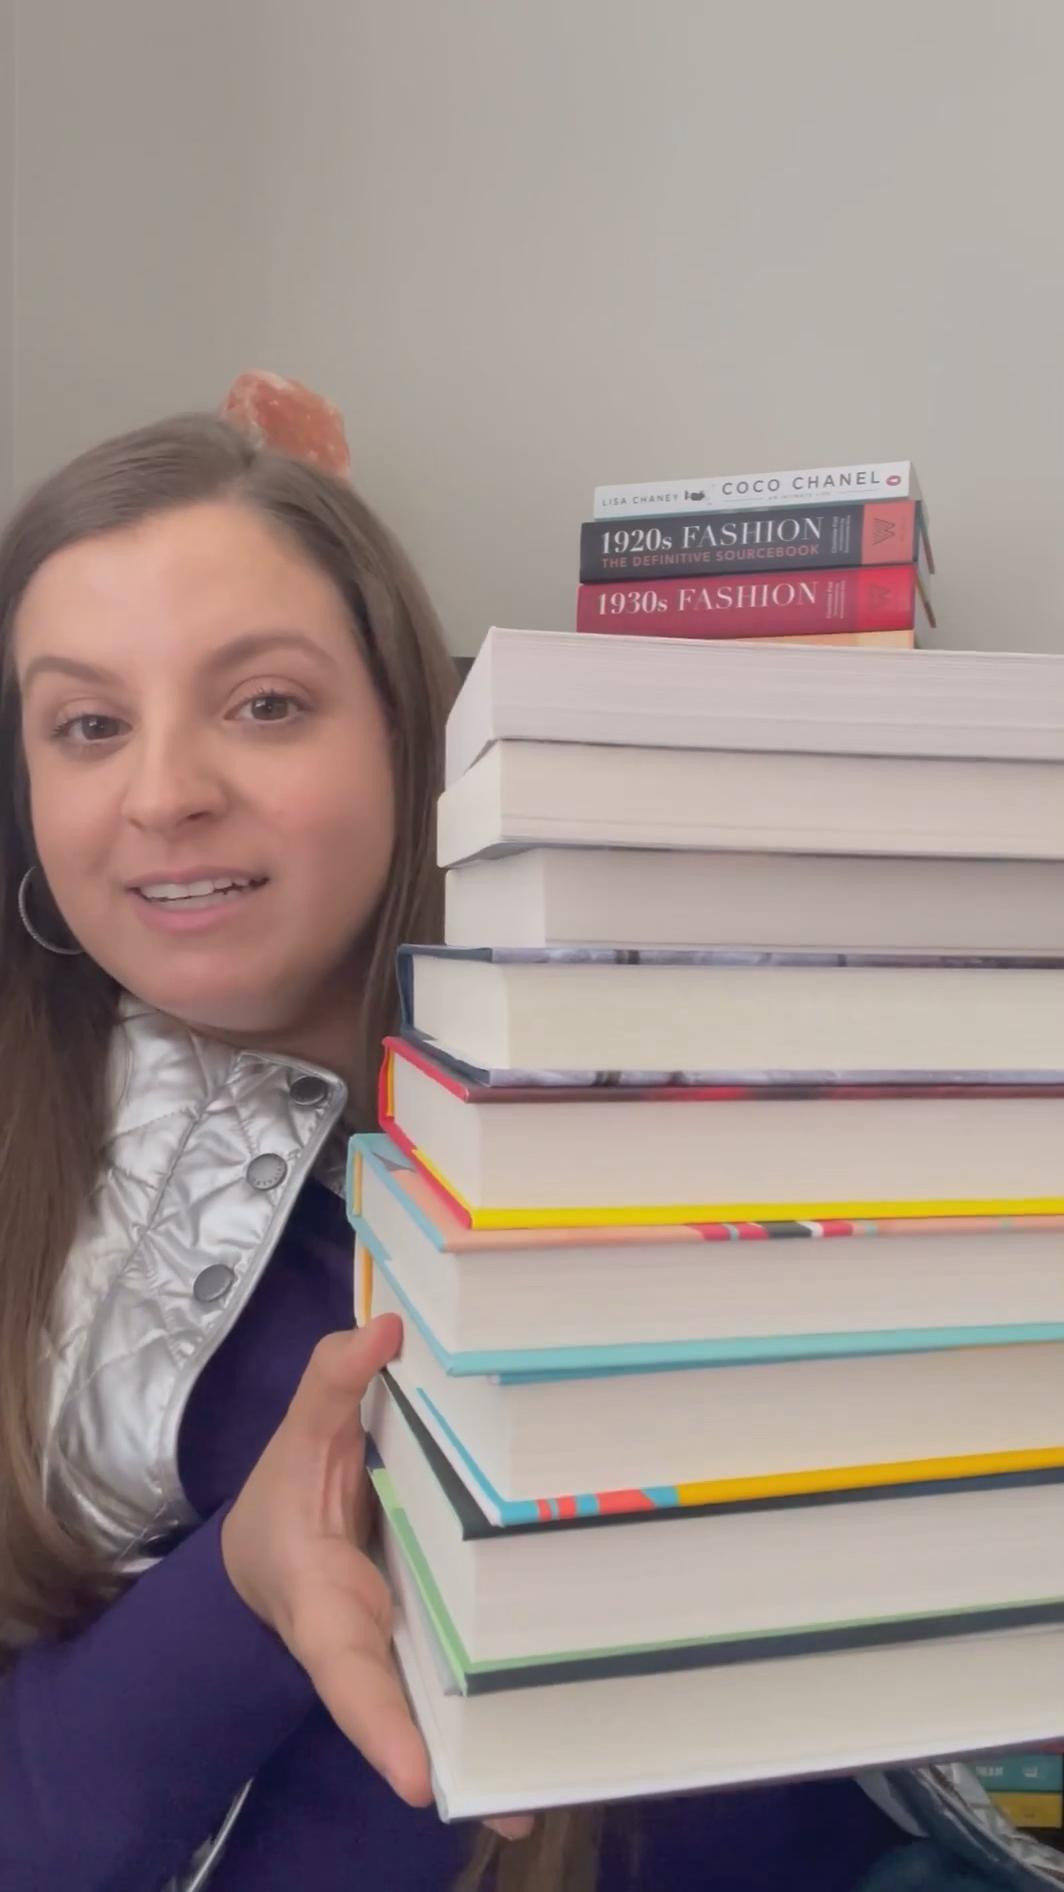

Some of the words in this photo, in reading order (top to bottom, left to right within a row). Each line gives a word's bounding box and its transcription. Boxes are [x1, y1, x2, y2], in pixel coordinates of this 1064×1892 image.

[722, 479, 780, 495] COCO
[792, 471, 880, 490] CHANEL
[602, 498, 627, 507] LISA
[632, 494, 678, 504] CHANEY
[602, 528, 672, 554] 1920s
[682, 517, 824, 549] FASHION
[602, 557, 627, 568] THE
[633, 551, 711, 567] DEFINITIVE
[716, 544, 819, 562] SOURCEBOOK
[598, 590, 668, 615] 1930s
[678, 581, 818, 611] FASHION
